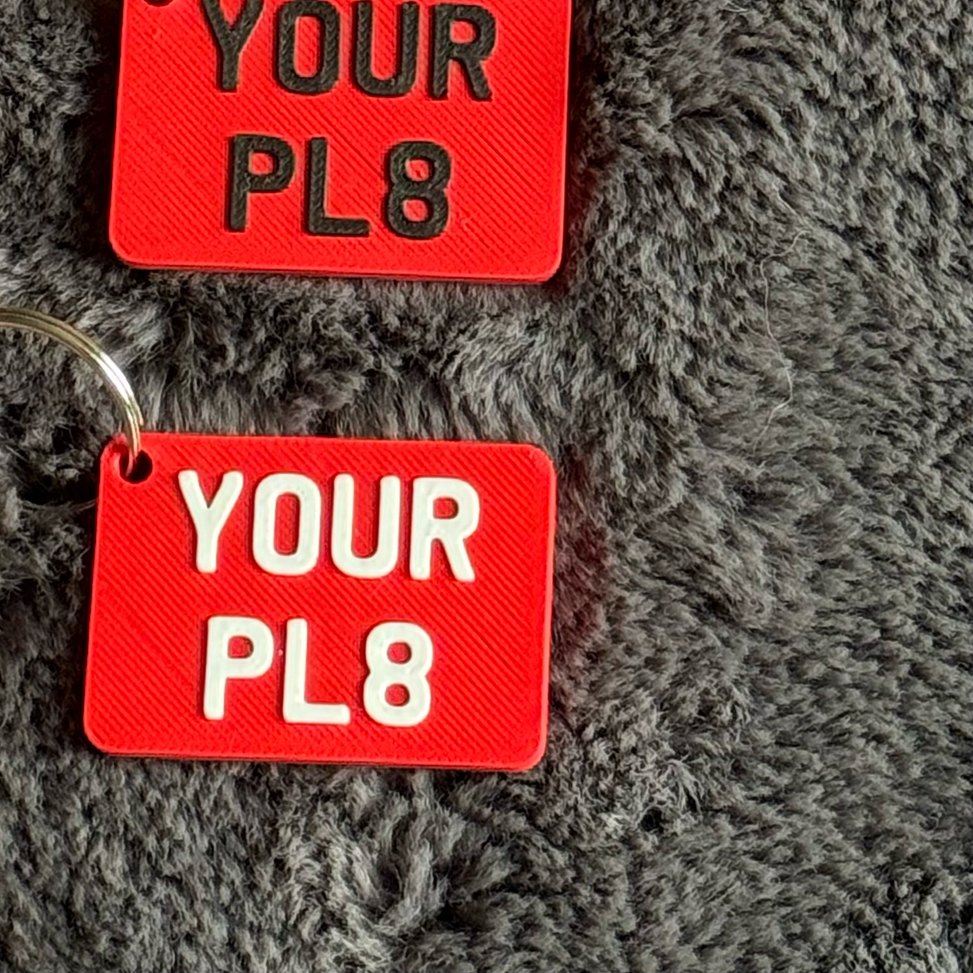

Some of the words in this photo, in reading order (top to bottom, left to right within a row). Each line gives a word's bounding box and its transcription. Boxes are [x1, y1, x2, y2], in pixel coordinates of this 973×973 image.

[227, 133, 452, 240] PL8
[178, 469, 481, 582] YOUR
[203, 615, 434, 727] PL8
